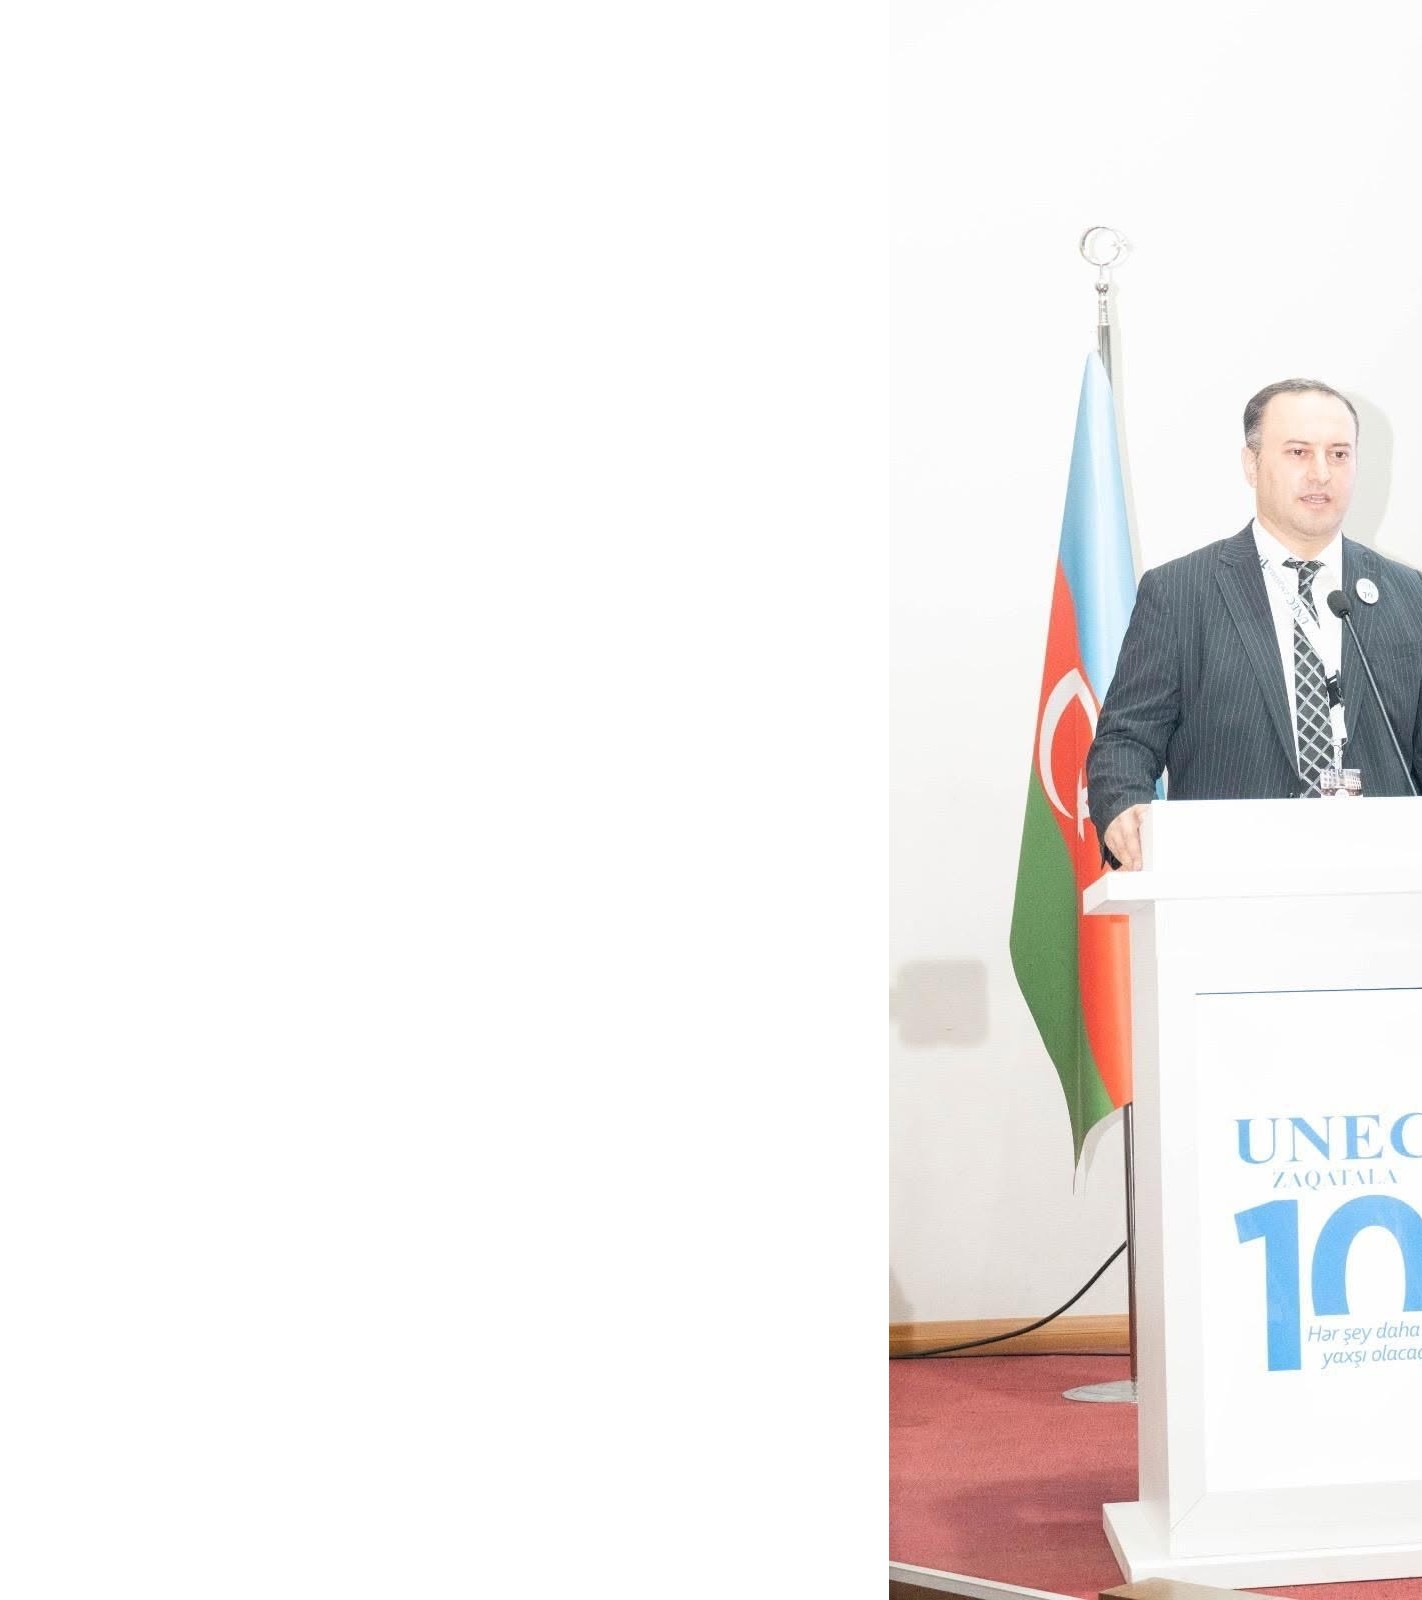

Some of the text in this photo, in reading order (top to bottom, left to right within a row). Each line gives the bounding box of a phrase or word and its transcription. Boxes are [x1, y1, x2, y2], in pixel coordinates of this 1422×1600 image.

[1273, 1168, 1398, 1190] ZAQATALA
[1307, 1325, 1340, 1342] Hər
[1344, 1327, 1373, 1345] şey
[1376, 1321, 1420, 1339] daha
[1321, 1350, 1366, 1369] yaxşı
